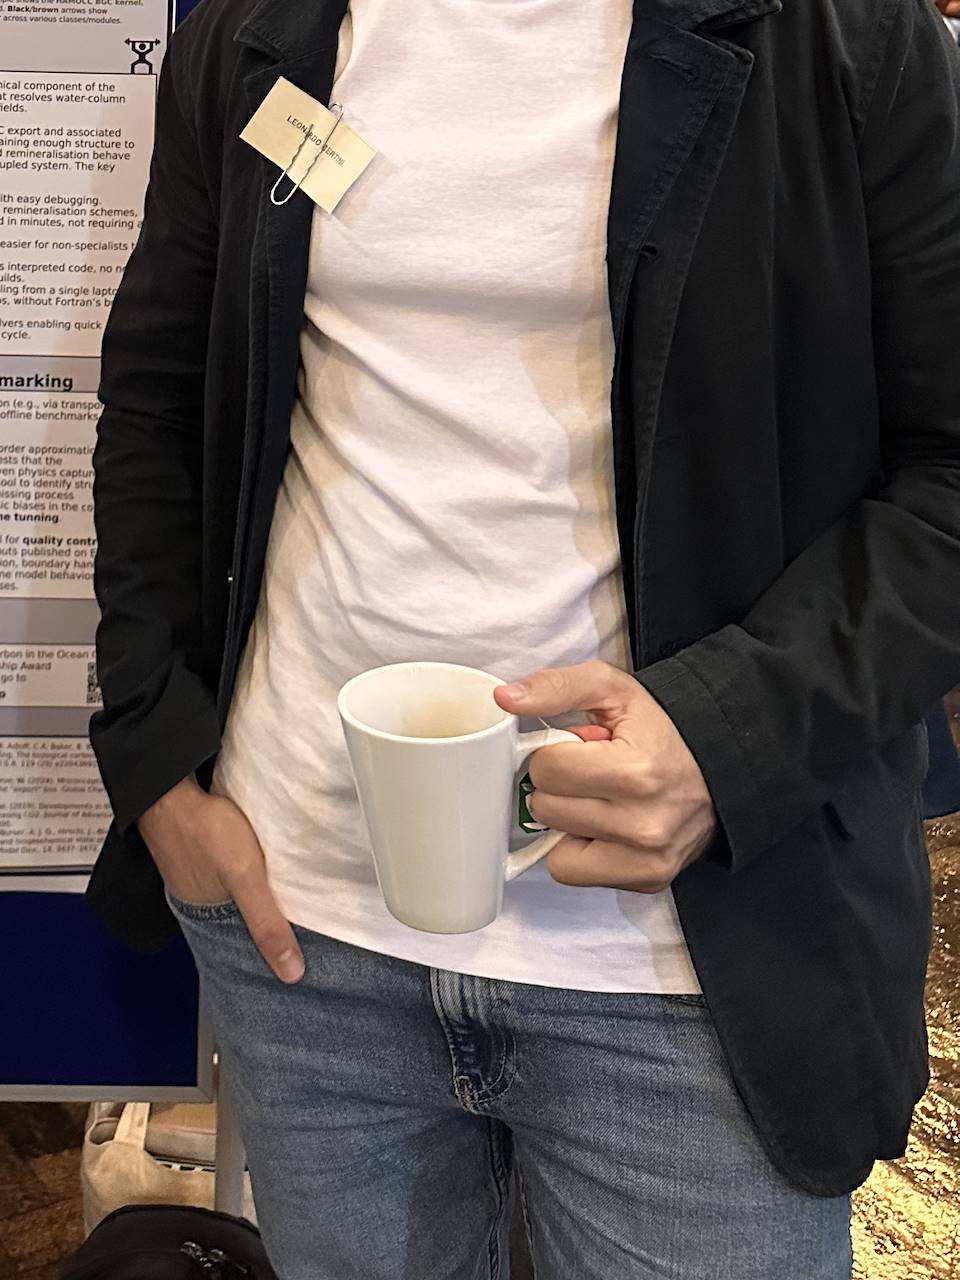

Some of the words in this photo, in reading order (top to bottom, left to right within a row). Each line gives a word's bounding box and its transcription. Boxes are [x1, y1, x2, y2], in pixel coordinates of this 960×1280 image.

[24, 82, 82, 93] component
[85, 82, 95, 92] of
[98, 82, 115, 92] the
[16, 196, 41, 207] easy
[44, 195, 102, 207] debugging.
[27, 320, 72, 332] enabling
[74, 320, 102, 332] quick
